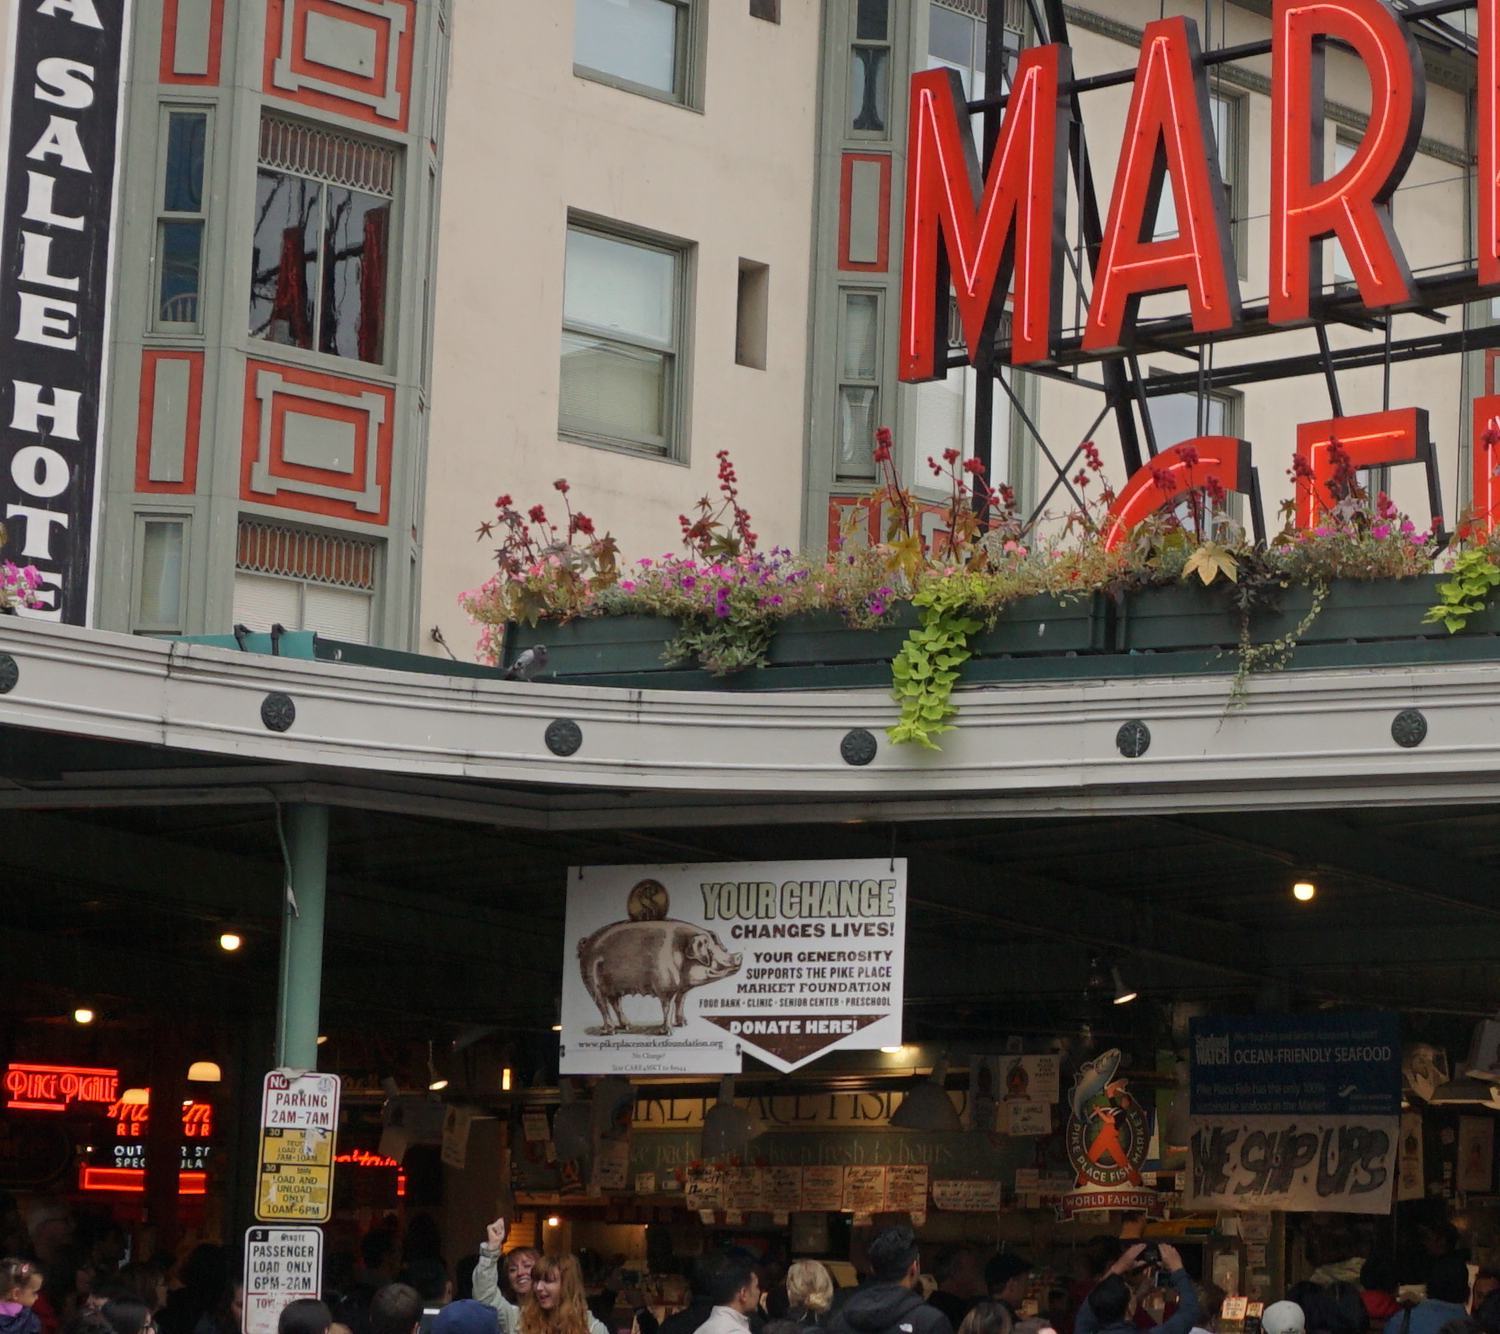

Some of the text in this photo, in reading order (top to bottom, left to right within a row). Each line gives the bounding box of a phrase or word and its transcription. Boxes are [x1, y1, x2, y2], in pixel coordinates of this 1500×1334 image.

[13, 56, 95, 353] SALLE
[700, 878, 897, 920] YOUR CHANGE
[730, 922, 895, 940] CHANGES LIVES!
[753, 950, 894, 963] YOUR GENEROSITY
[746, 966, 892, 980] SUPPORTS THE PIKE PLACE
[736, 981, 892, 994] MARKET FOUNDATION
[746, 998, 773, 1008] CLINIC
[779, 998, 808, 1008] SENIOR
[809, 997, 840, 1007] CENTER
[845, 996, 891, 1007] PRESCHOOL
[729, 1019, 859, 1035] DONATE HERE!
[1196, 1047, 1230, 1065] WATCH
[1234, 1046, 1392, 1064] OCEAN-FRIENDLY SEAFOOD
[270, 1076, 288, 1089] NO
[275, 1092, 329, 1108] PARKING
[270, 1109, 330, 1126] 2AM-7AM
[269, 1129, 280, 1137] 30
[1071, 1122, 1081, 1154] PIKE
[1077, 1158, 1107, 1183] PLACE
[1109, 1163, 1134, 1181] FISH
[1130, 1110, 1142, 1163] MARKET
[265, 1164, 277, 1173] 30
[1190, 1125, 1240, 1200] WE
[1316, 1124, 1390, 1198] UPS
[272, 1175, 318, 1186] LOAD AND
[276, 1184, 313, 1194] UNLOAD
[282, 1194, 306, 1204] ONLY
[1065, 1194, 1156, 1207] WORLD FAMOUS
[266, 1204, 320, 1216] 10AM-6PM
[252, 1245, 315, 1258] PASSENGER
[253, 1260, 313, 1274] LOAD ONLY
[253, 1276, 312, 1291] 6PM-2AM
